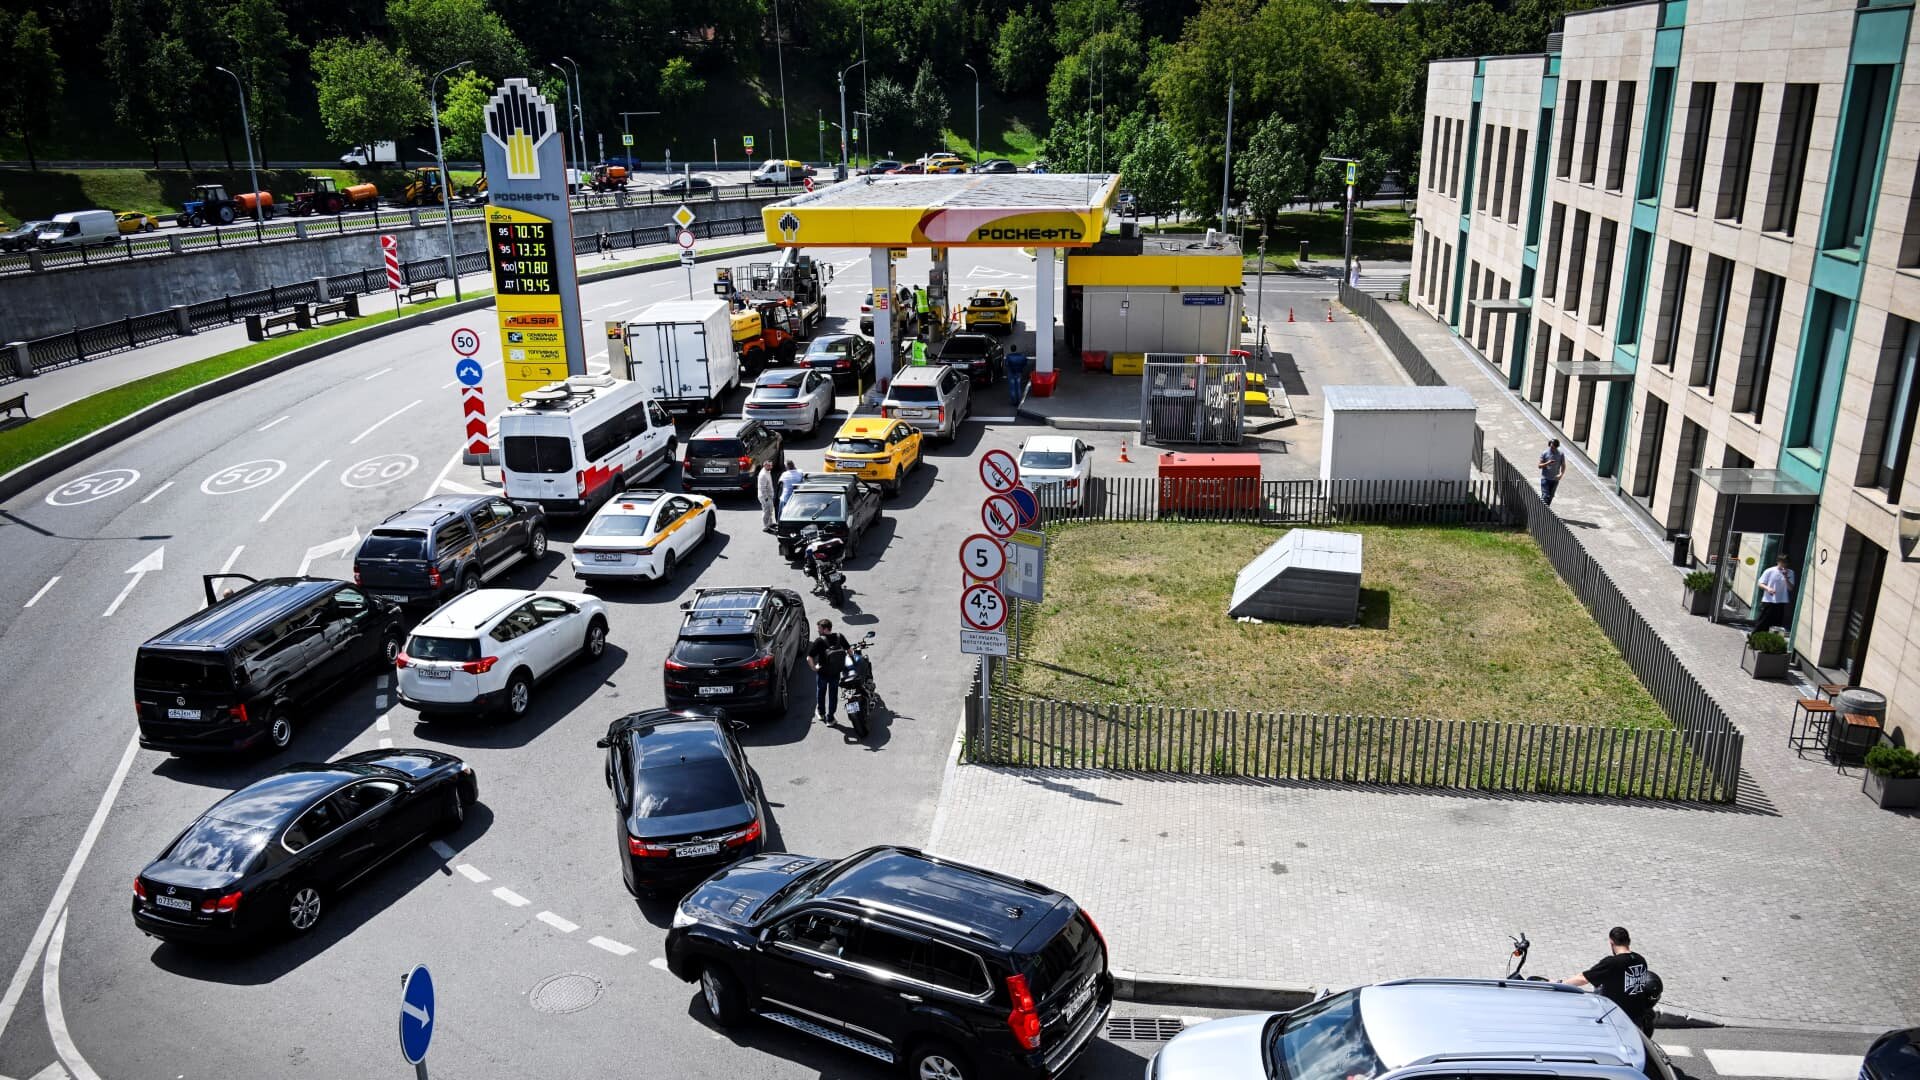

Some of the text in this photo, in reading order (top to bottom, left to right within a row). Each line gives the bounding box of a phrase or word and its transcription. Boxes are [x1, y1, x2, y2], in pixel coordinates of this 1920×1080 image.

[493, 193, 560, 201] РОСНЕФТЬ
[498, 225, 544, 239] 95 70.75
[978, 228, 1082, 240] РОСНЕФТЬ
[501, 243, 546, 257] 95 73.35
[518, 261, 548, 275] 97.80
[504, 279, 550, 292] ДТ 79.45
[457, 336, 474, 348] 50
[215, 467, 273, 486] 50
[353, 461, 407, 479] 50
[64, 477, 124, 495] 50
[976, 549, 988, 567] 5
[970, 593, 997, 611] 4,5
